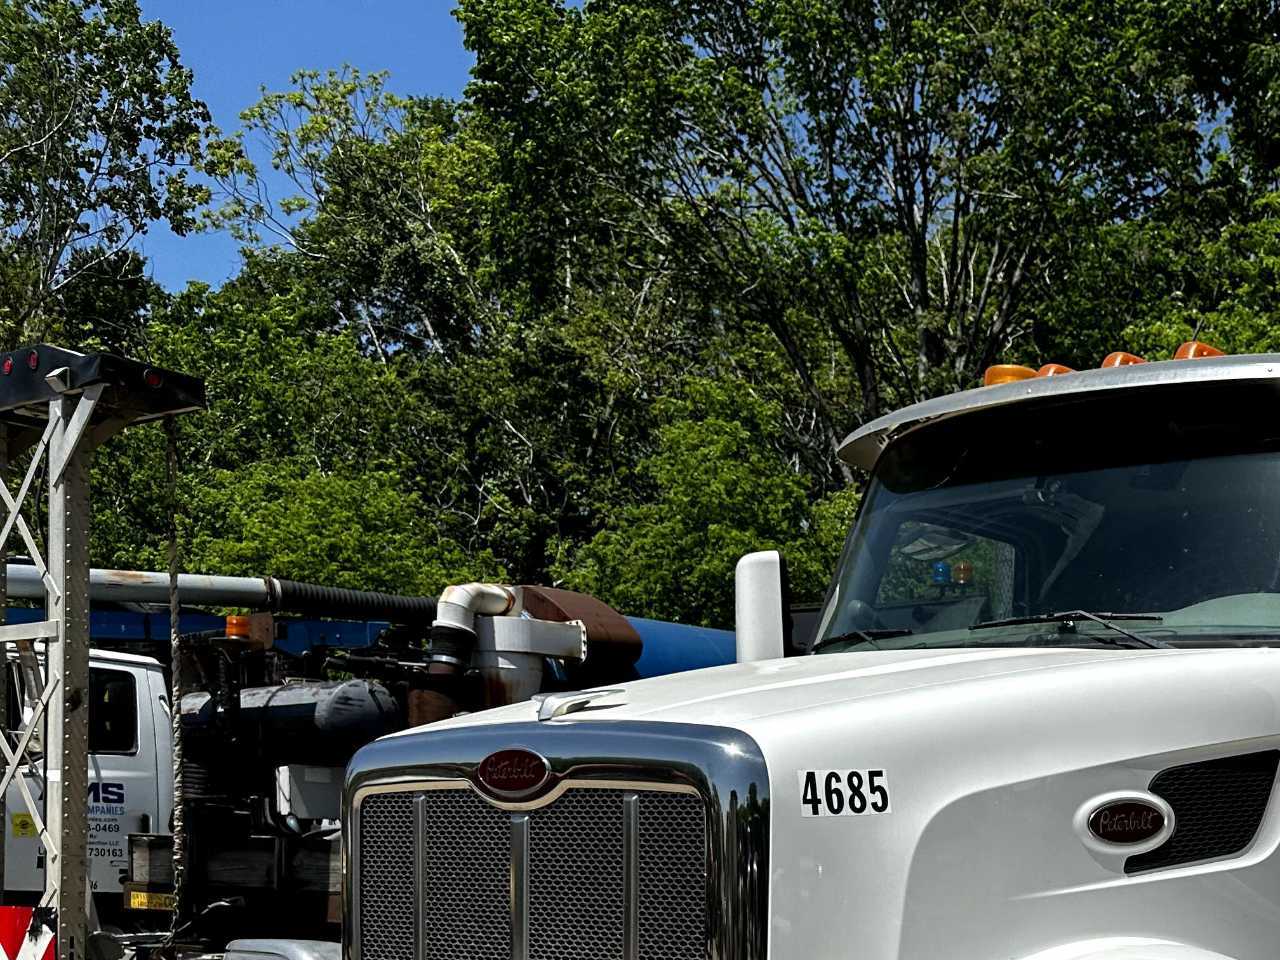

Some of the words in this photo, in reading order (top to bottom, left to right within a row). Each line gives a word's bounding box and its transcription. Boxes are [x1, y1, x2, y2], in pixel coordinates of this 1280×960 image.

[88, 782, 125, 804] MS
[802, 770, 889, 815] 4685
[88, 804, 125, 816] MPANIES
[1100, 809, 1159, 834] Peterbilt
